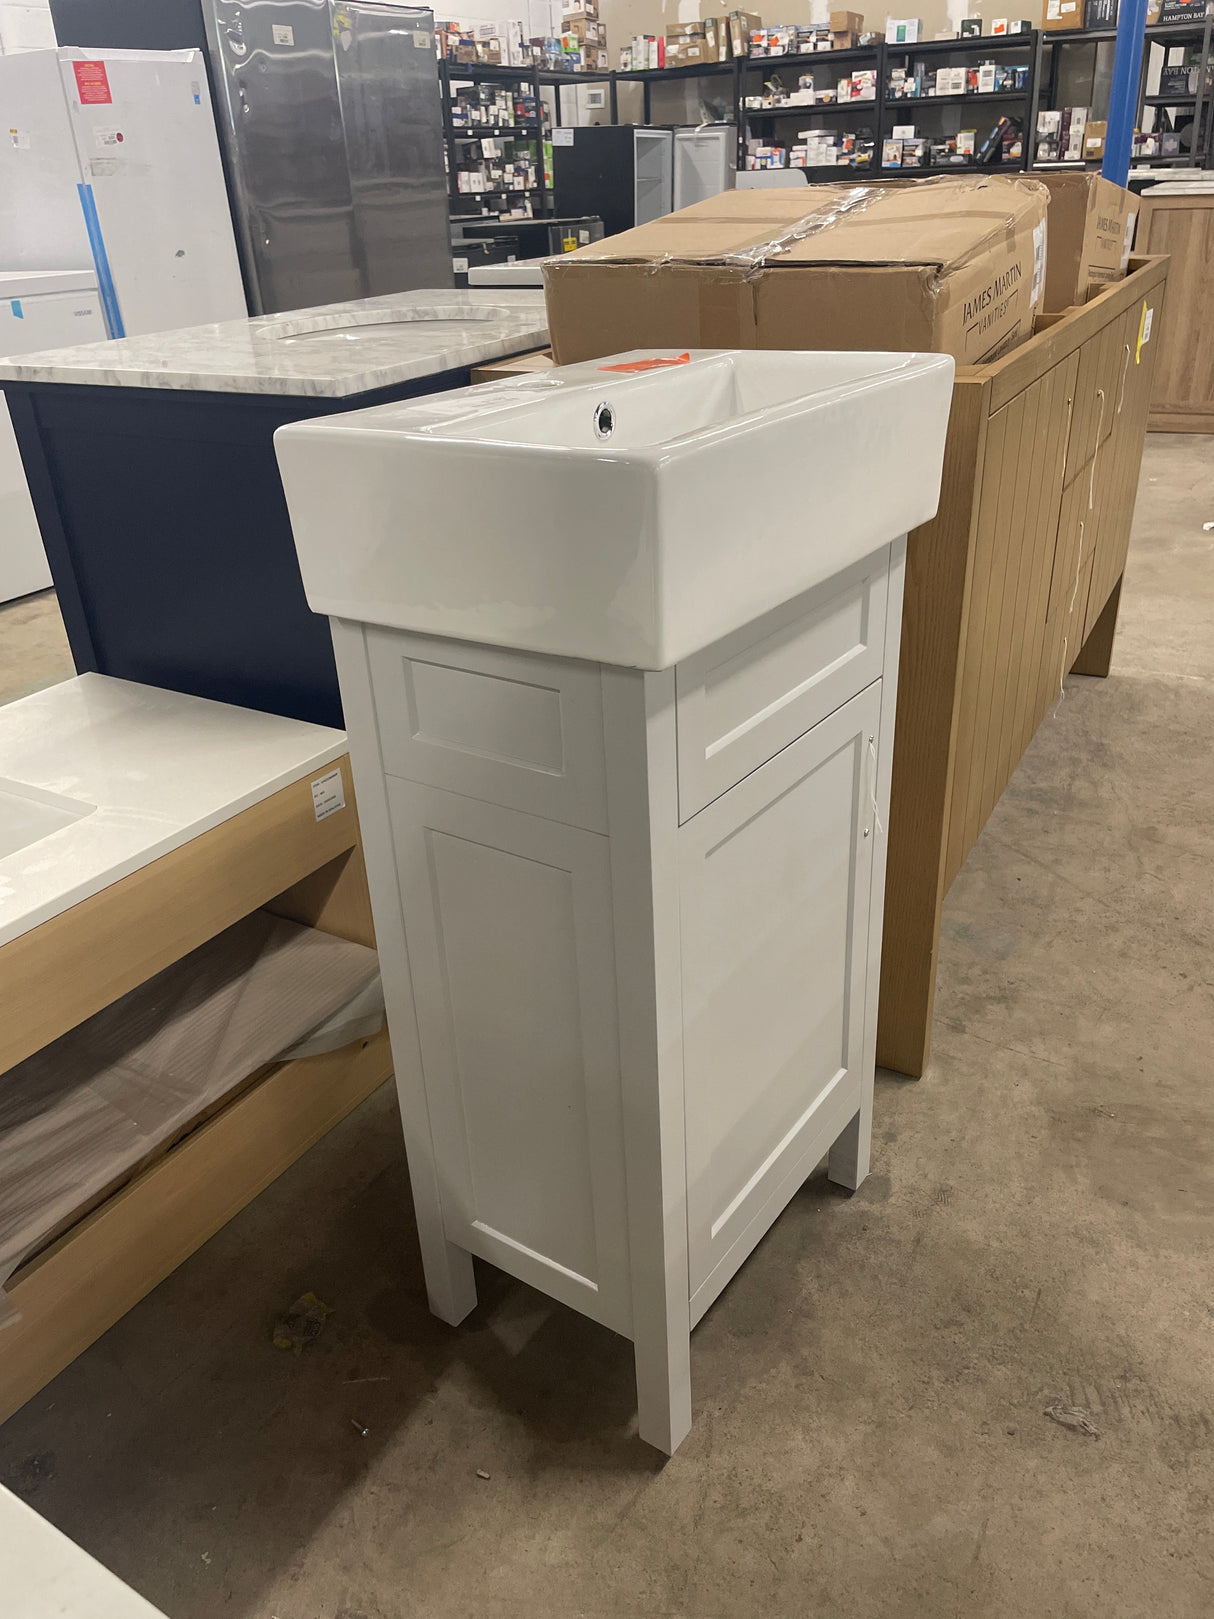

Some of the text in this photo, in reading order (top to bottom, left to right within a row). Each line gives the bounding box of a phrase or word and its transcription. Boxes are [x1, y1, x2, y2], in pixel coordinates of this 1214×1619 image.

[1163, 11, 1205, 22] HAMPTON BAY
[962, 286, 992, 326] JAMES
[992, 261, 1022, 301] MARTIN
[978, 297, 1011, 335] VANITIES
